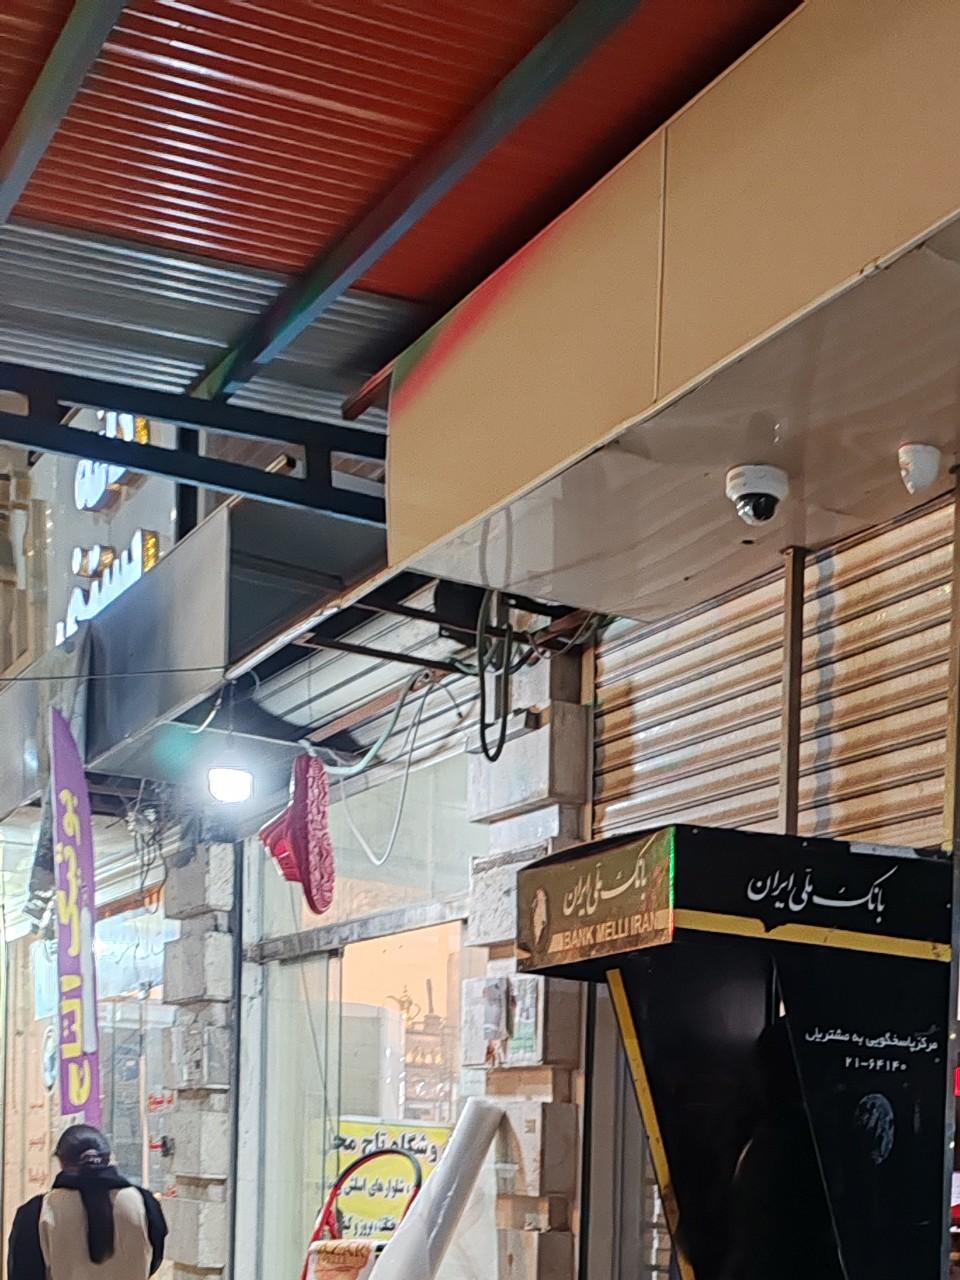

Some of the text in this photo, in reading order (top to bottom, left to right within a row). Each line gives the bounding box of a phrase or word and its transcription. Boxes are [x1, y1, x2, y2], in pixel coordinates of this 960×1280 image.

[601, 838, 650, 900] بانک
[563, 872, 592, 916] ایران
[747, 870, 795, 908] ایران
[813, 865, 898, 923] بانک
[561, 911, 657, 950] BANK MELLI IRAN
[852, 1033, 864, 1046] به
[865, 1032, 915, 1052] پاسخگویی
[914, 1036, 938, 1052] مرکز
